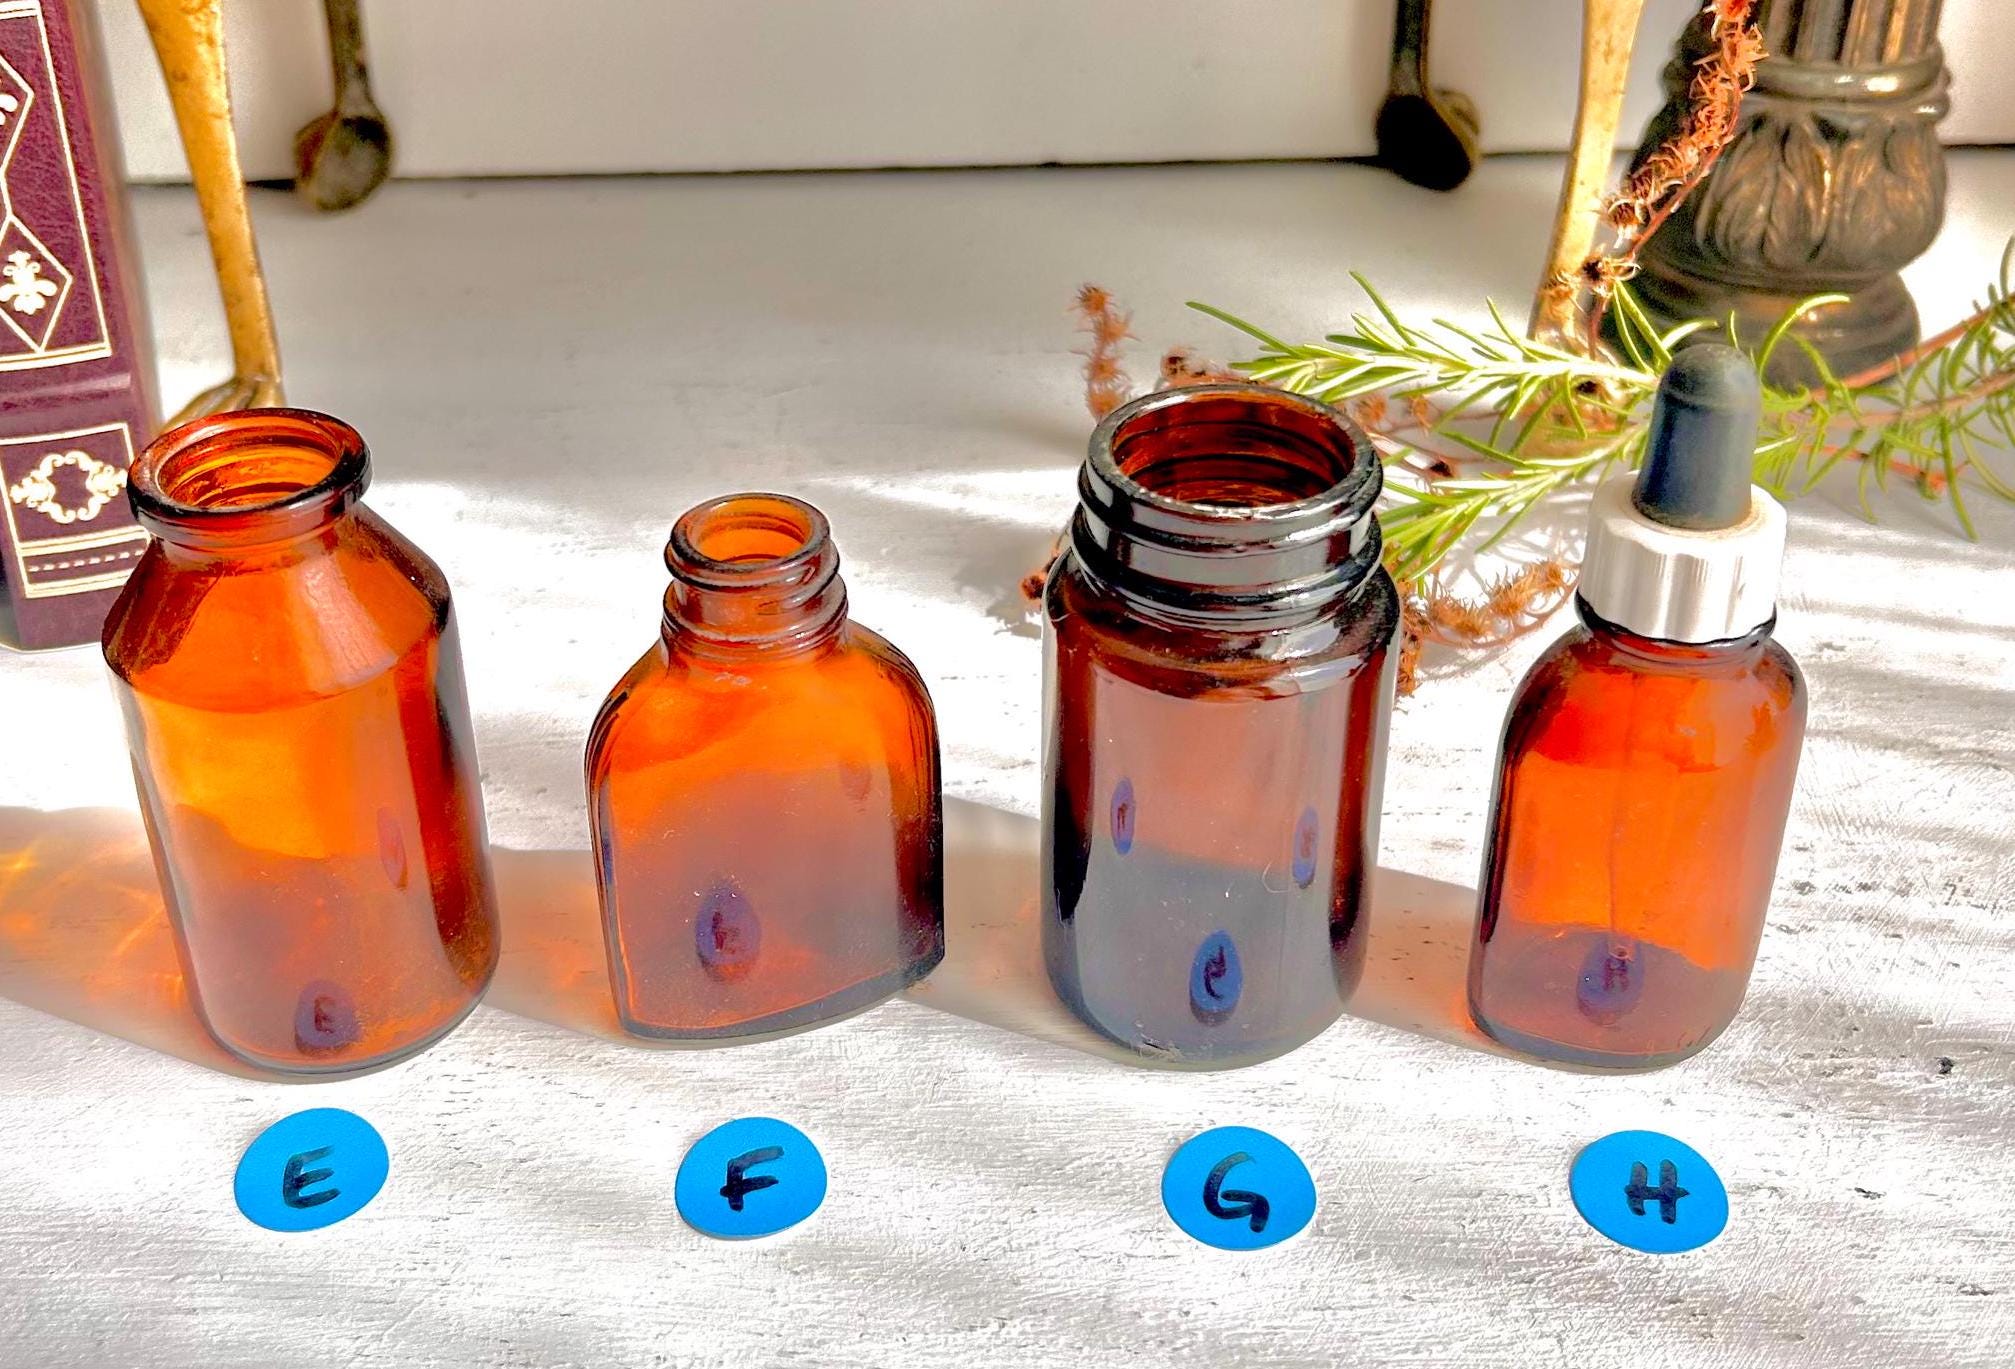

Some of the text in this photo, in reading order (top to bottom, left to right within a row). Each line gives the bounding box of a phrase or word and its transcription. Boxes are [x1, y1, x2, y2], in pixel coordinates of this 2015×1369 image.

[282, 1144, 341, 1209] E
[719, 1145, 785, 1212] F
[1203, 1151, 1271, 1233] G
[1624, 1158, 1690, 1225] H
